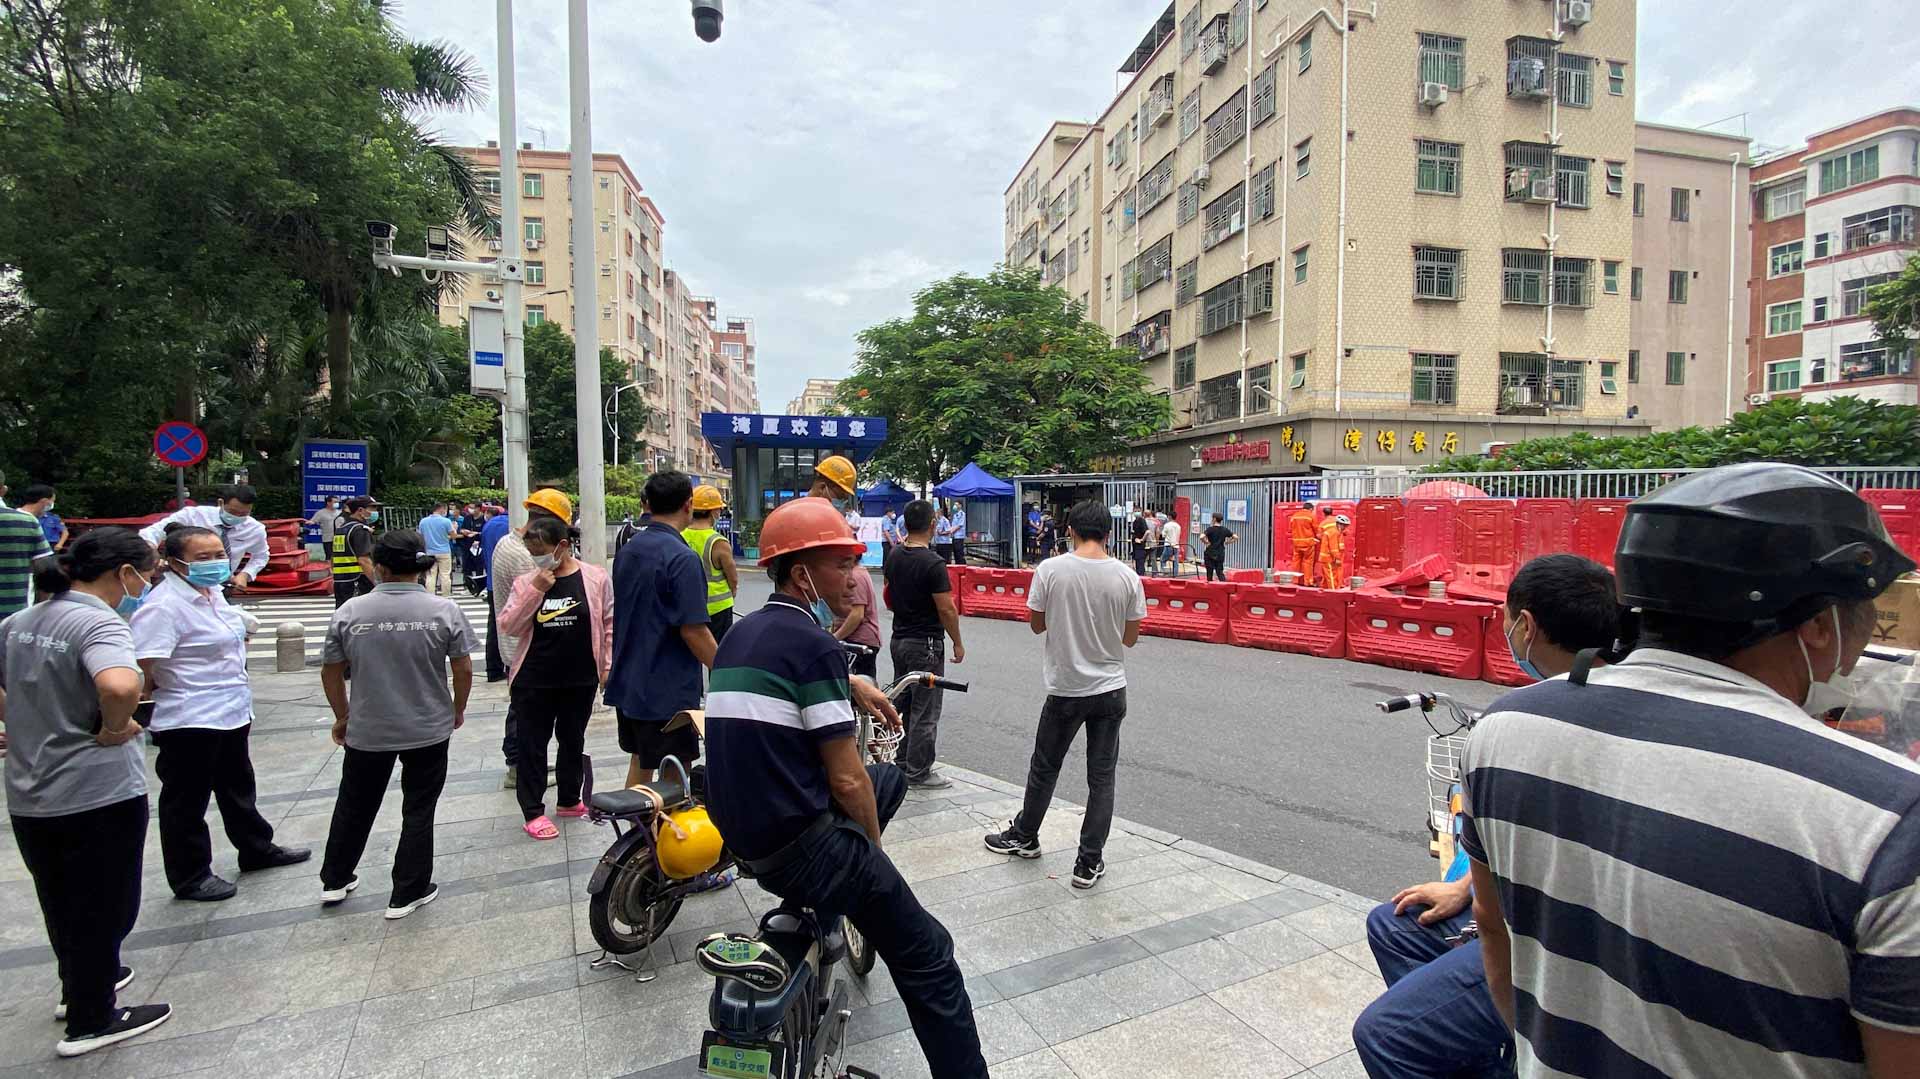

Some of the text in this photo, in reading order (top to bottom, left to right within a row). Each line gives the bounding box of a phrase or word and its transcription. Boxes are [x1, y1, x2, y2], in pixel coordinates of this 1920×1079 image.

[731, 415, 866, 438] 湾厦欢迎您
[1281, 425, 1306, 463] 湾仔
[1344, 428, 1460, 454] 湾仔餐厅
[311, 450, 361, 460] 深圳市蛇口湾厦
[308, 461, 364, 470] 实业股份有限公司
[316, 484, 356, 492] 深圳市蛇口
[541, 597, 573, 611] NIKE
